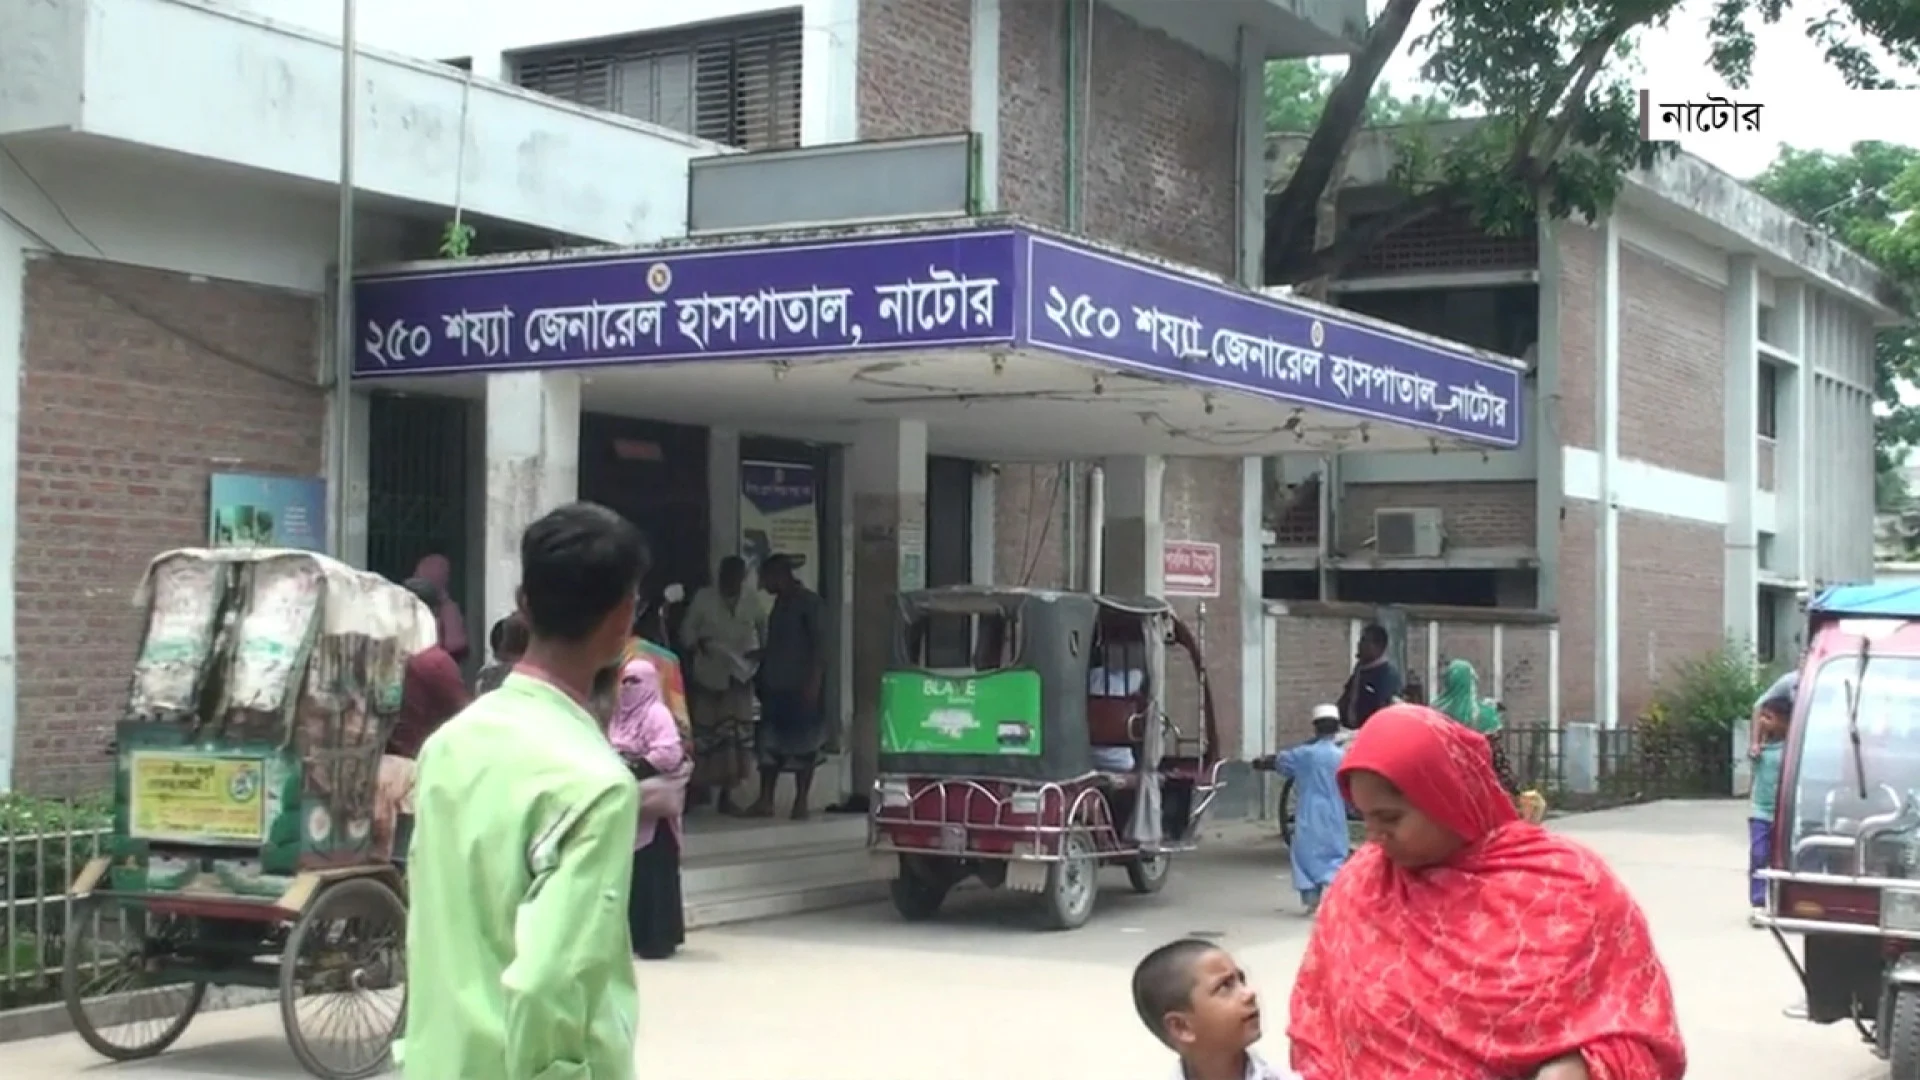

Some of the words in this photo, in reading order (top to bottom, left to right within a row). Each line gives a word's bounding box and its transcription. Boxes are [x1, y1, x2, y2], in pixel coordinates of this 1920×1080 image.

[365, 319, 431, 366] ২৫০
[441, 304, 513, 357] শয্যা
[525, 299, 667, 353] জেনারেল
[675, 284, 863, 349] হাসপাতাল,
[874, 263, 999, 335] নাটোর
[1044, 285, 1121, 339] ২৫০
[1132, 305, 1203, 357] শয্যা
[1212, 327, 1322, 388] জেনারেল
[1448, 379, 1508, 428] নাটোর
